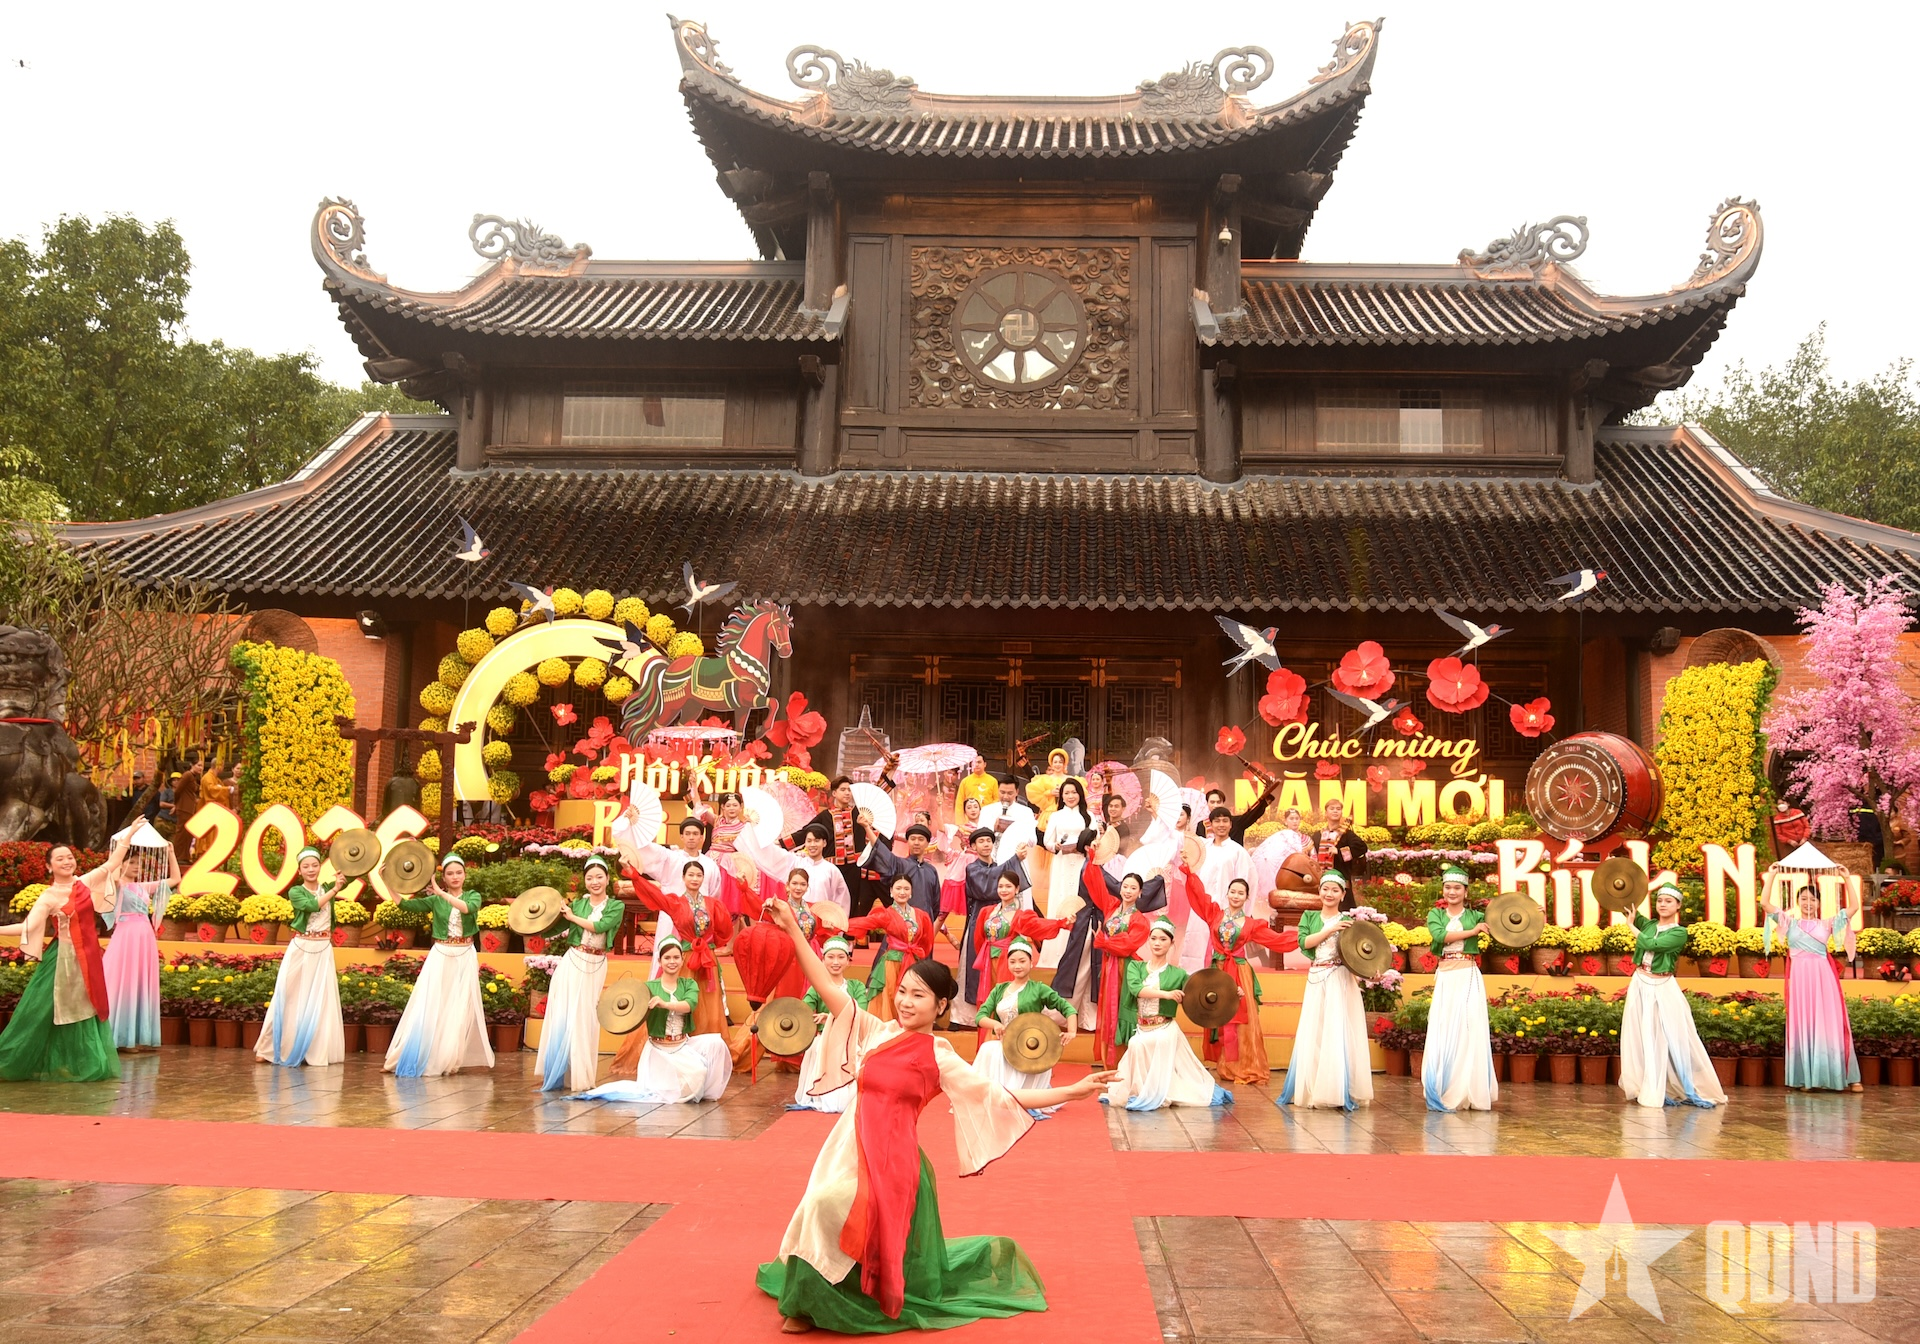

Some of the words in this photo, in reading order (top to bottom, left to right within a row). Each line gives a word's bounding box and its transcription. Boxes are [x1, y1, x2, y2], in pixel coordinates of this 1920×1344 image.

[1272, 722, 1362, 761] Chúc
[1373, 731, 1480, 776] mừng
[1387, 768, 1505, 827] MỚI
